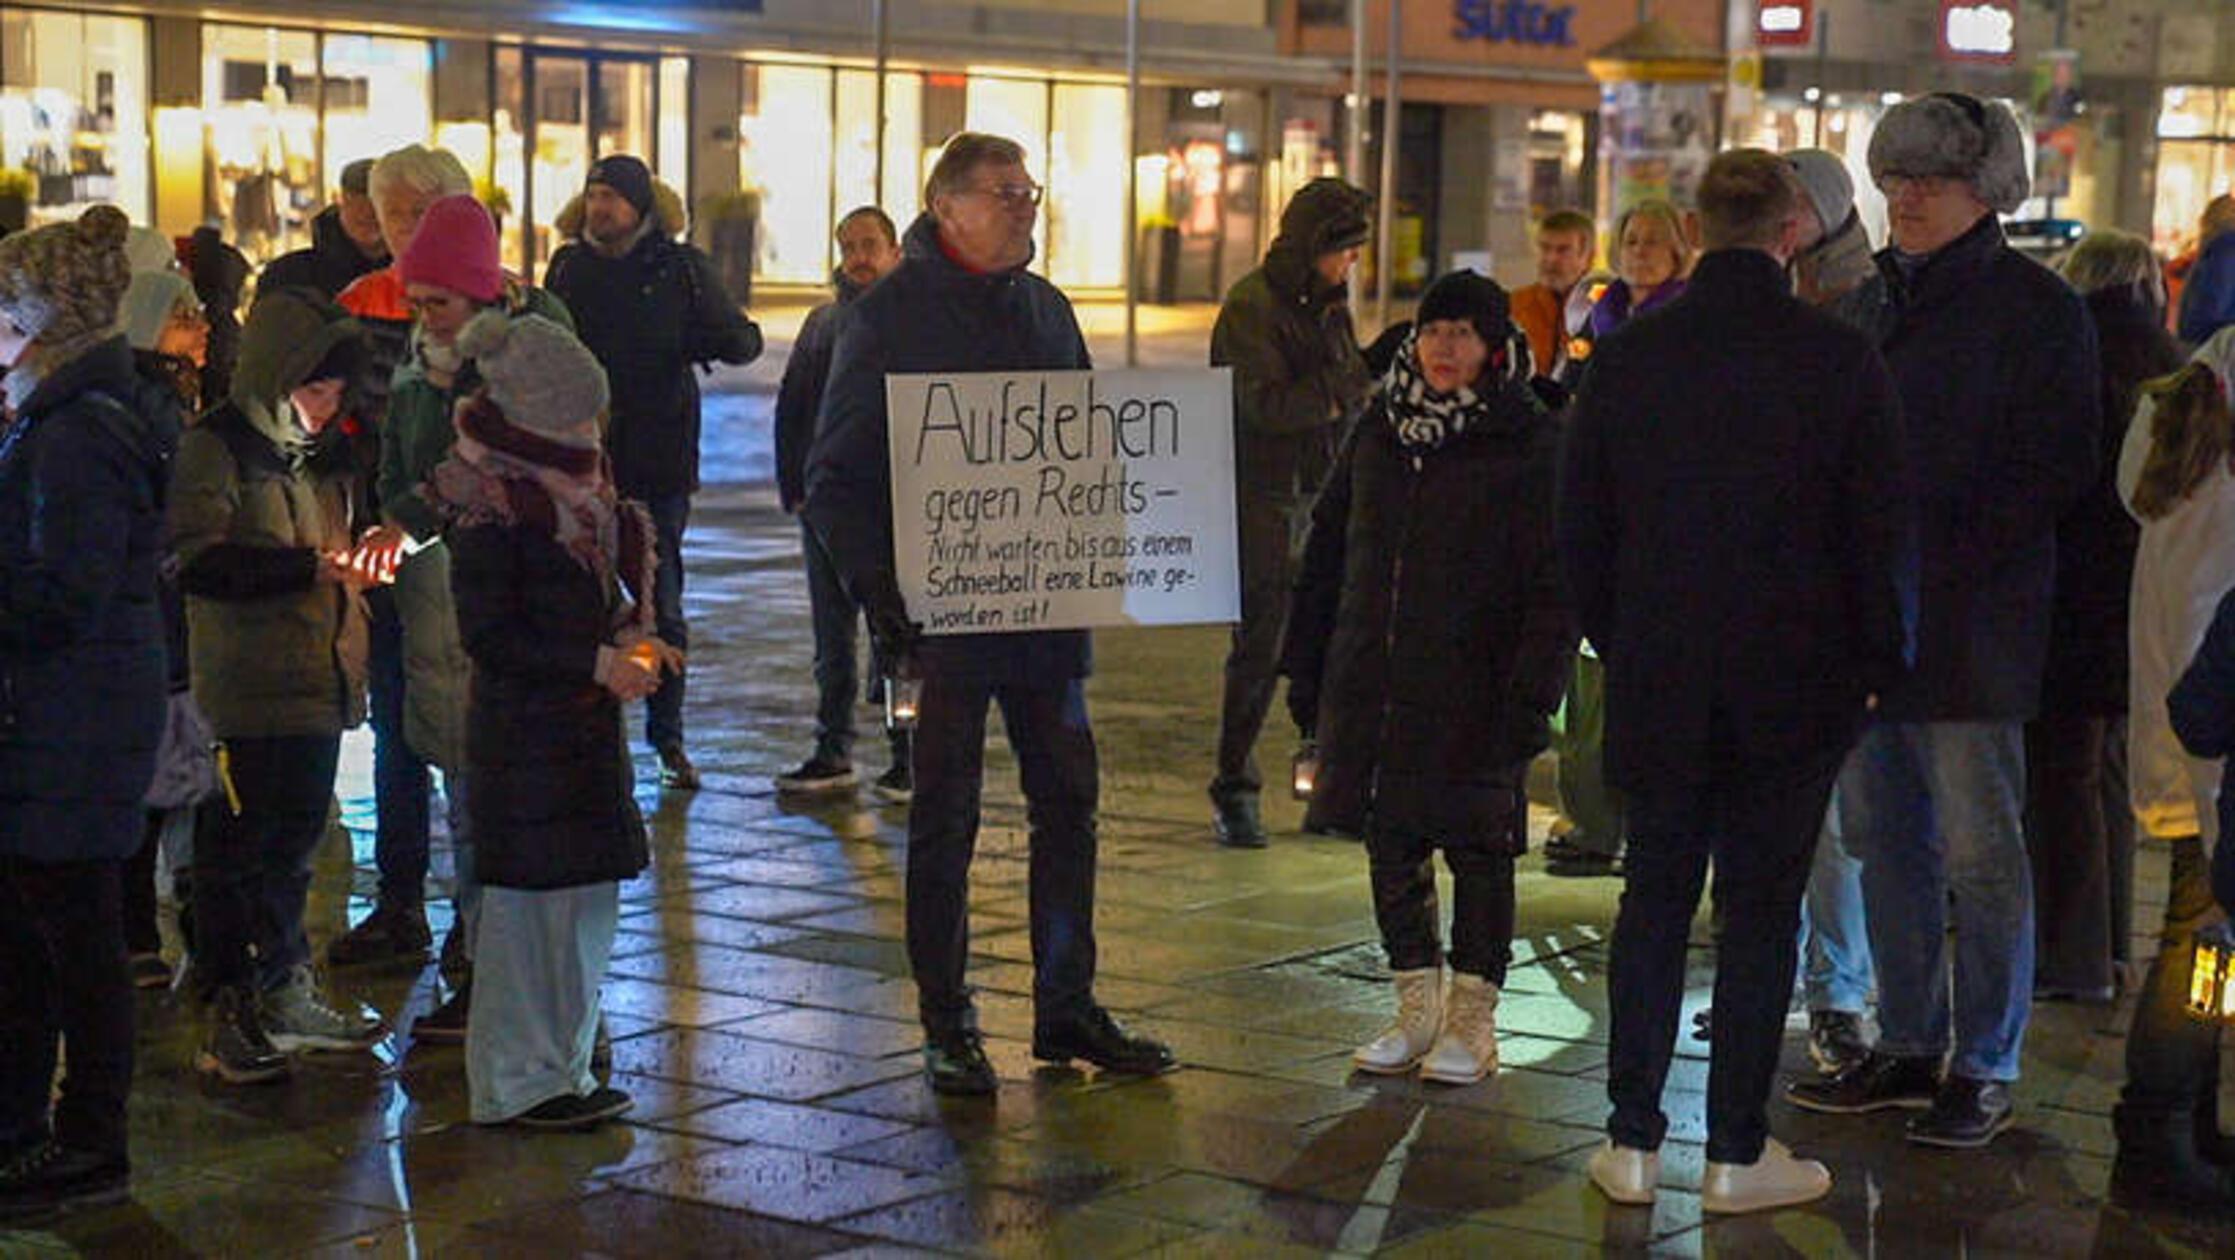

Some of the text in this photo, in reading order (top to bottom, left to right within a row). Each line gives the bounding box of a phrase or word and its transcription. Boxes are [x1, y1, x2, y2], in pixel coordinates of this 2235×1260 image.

[914, 378, 1179, 466] Aufstehen
[925, 487, 1020, 535] gegen
[1064, 527, 1098, 560] bis
[1100, 536, 1137, 559] aus
[1142, 536, 1193, 557] einem
[926, 561, 1197, 598] Schneeball eine Lawine ge-
[930, 602, 1004, 629] worden
